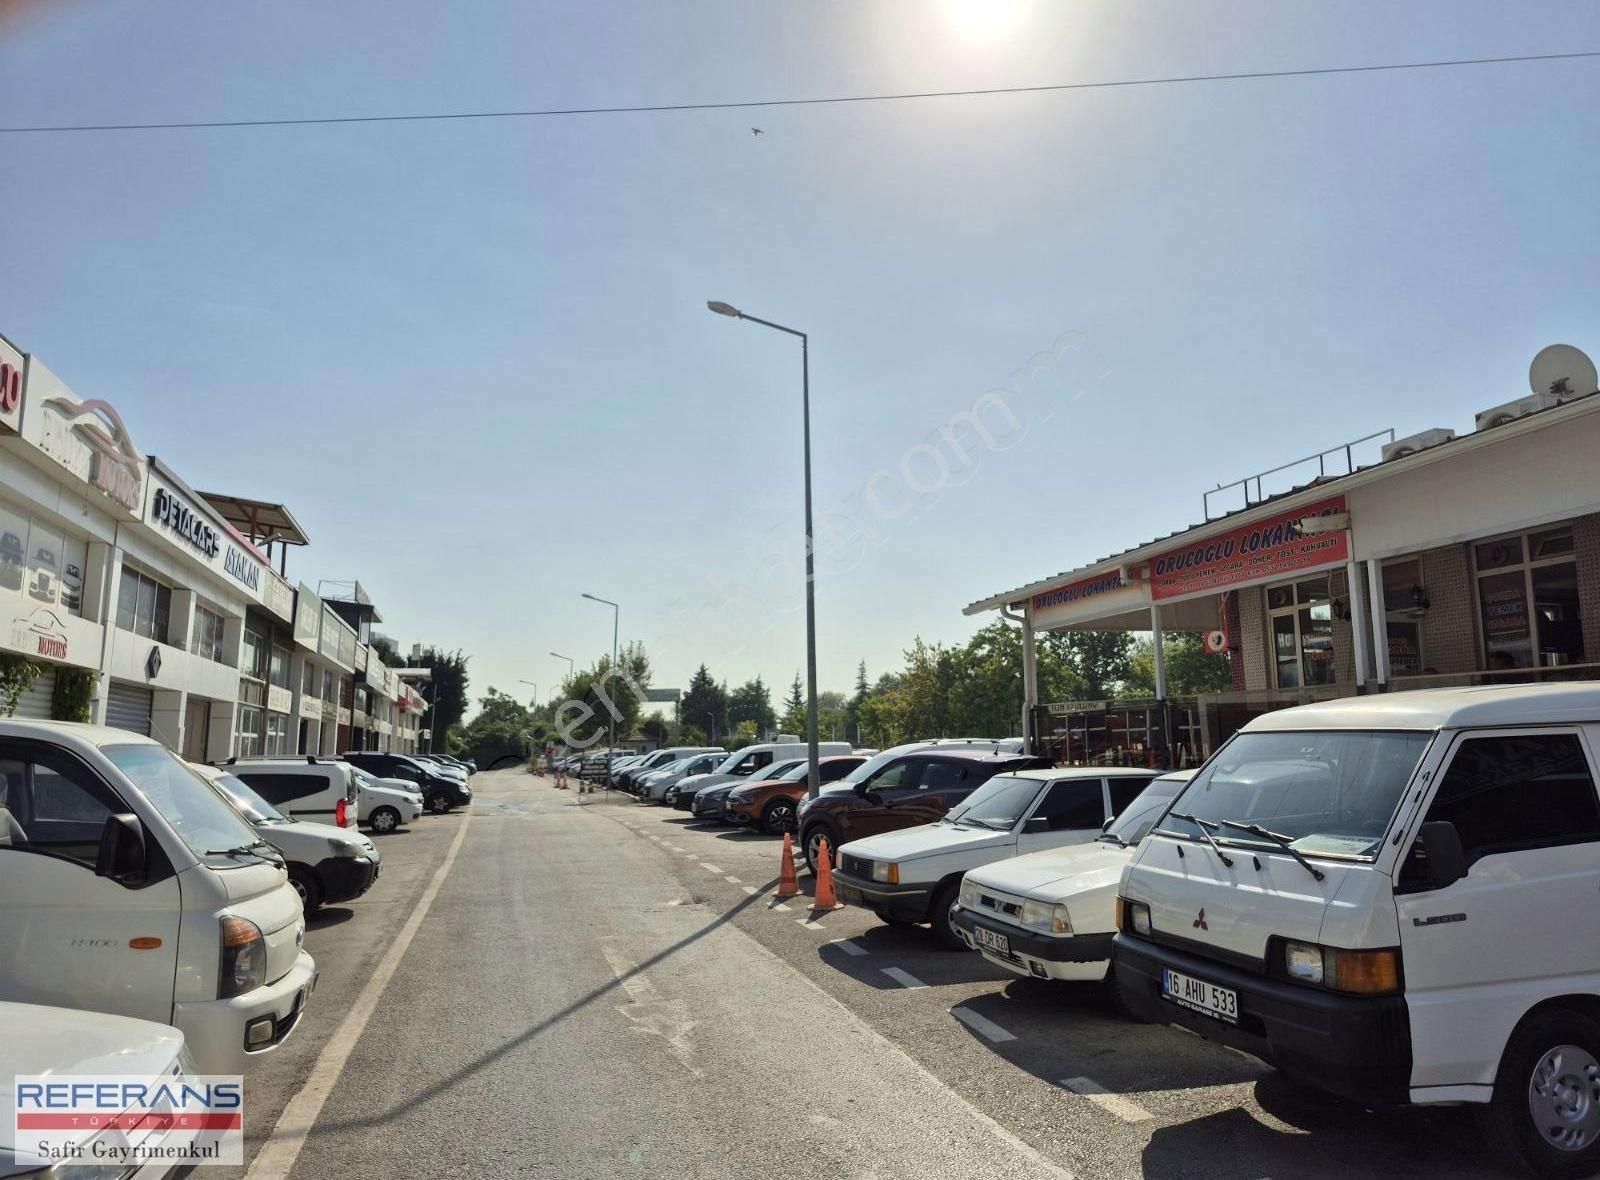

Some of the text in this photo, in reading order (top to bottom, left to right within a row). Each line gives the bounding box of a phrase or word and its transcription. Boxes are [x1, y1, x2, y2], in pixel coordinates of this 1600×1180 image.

[1240, 506, 1340, 554] LOKAN
[224, 543, 259, 592] ATAKAN
[1168, 972, 1235, 1014] 16 AHU 533
